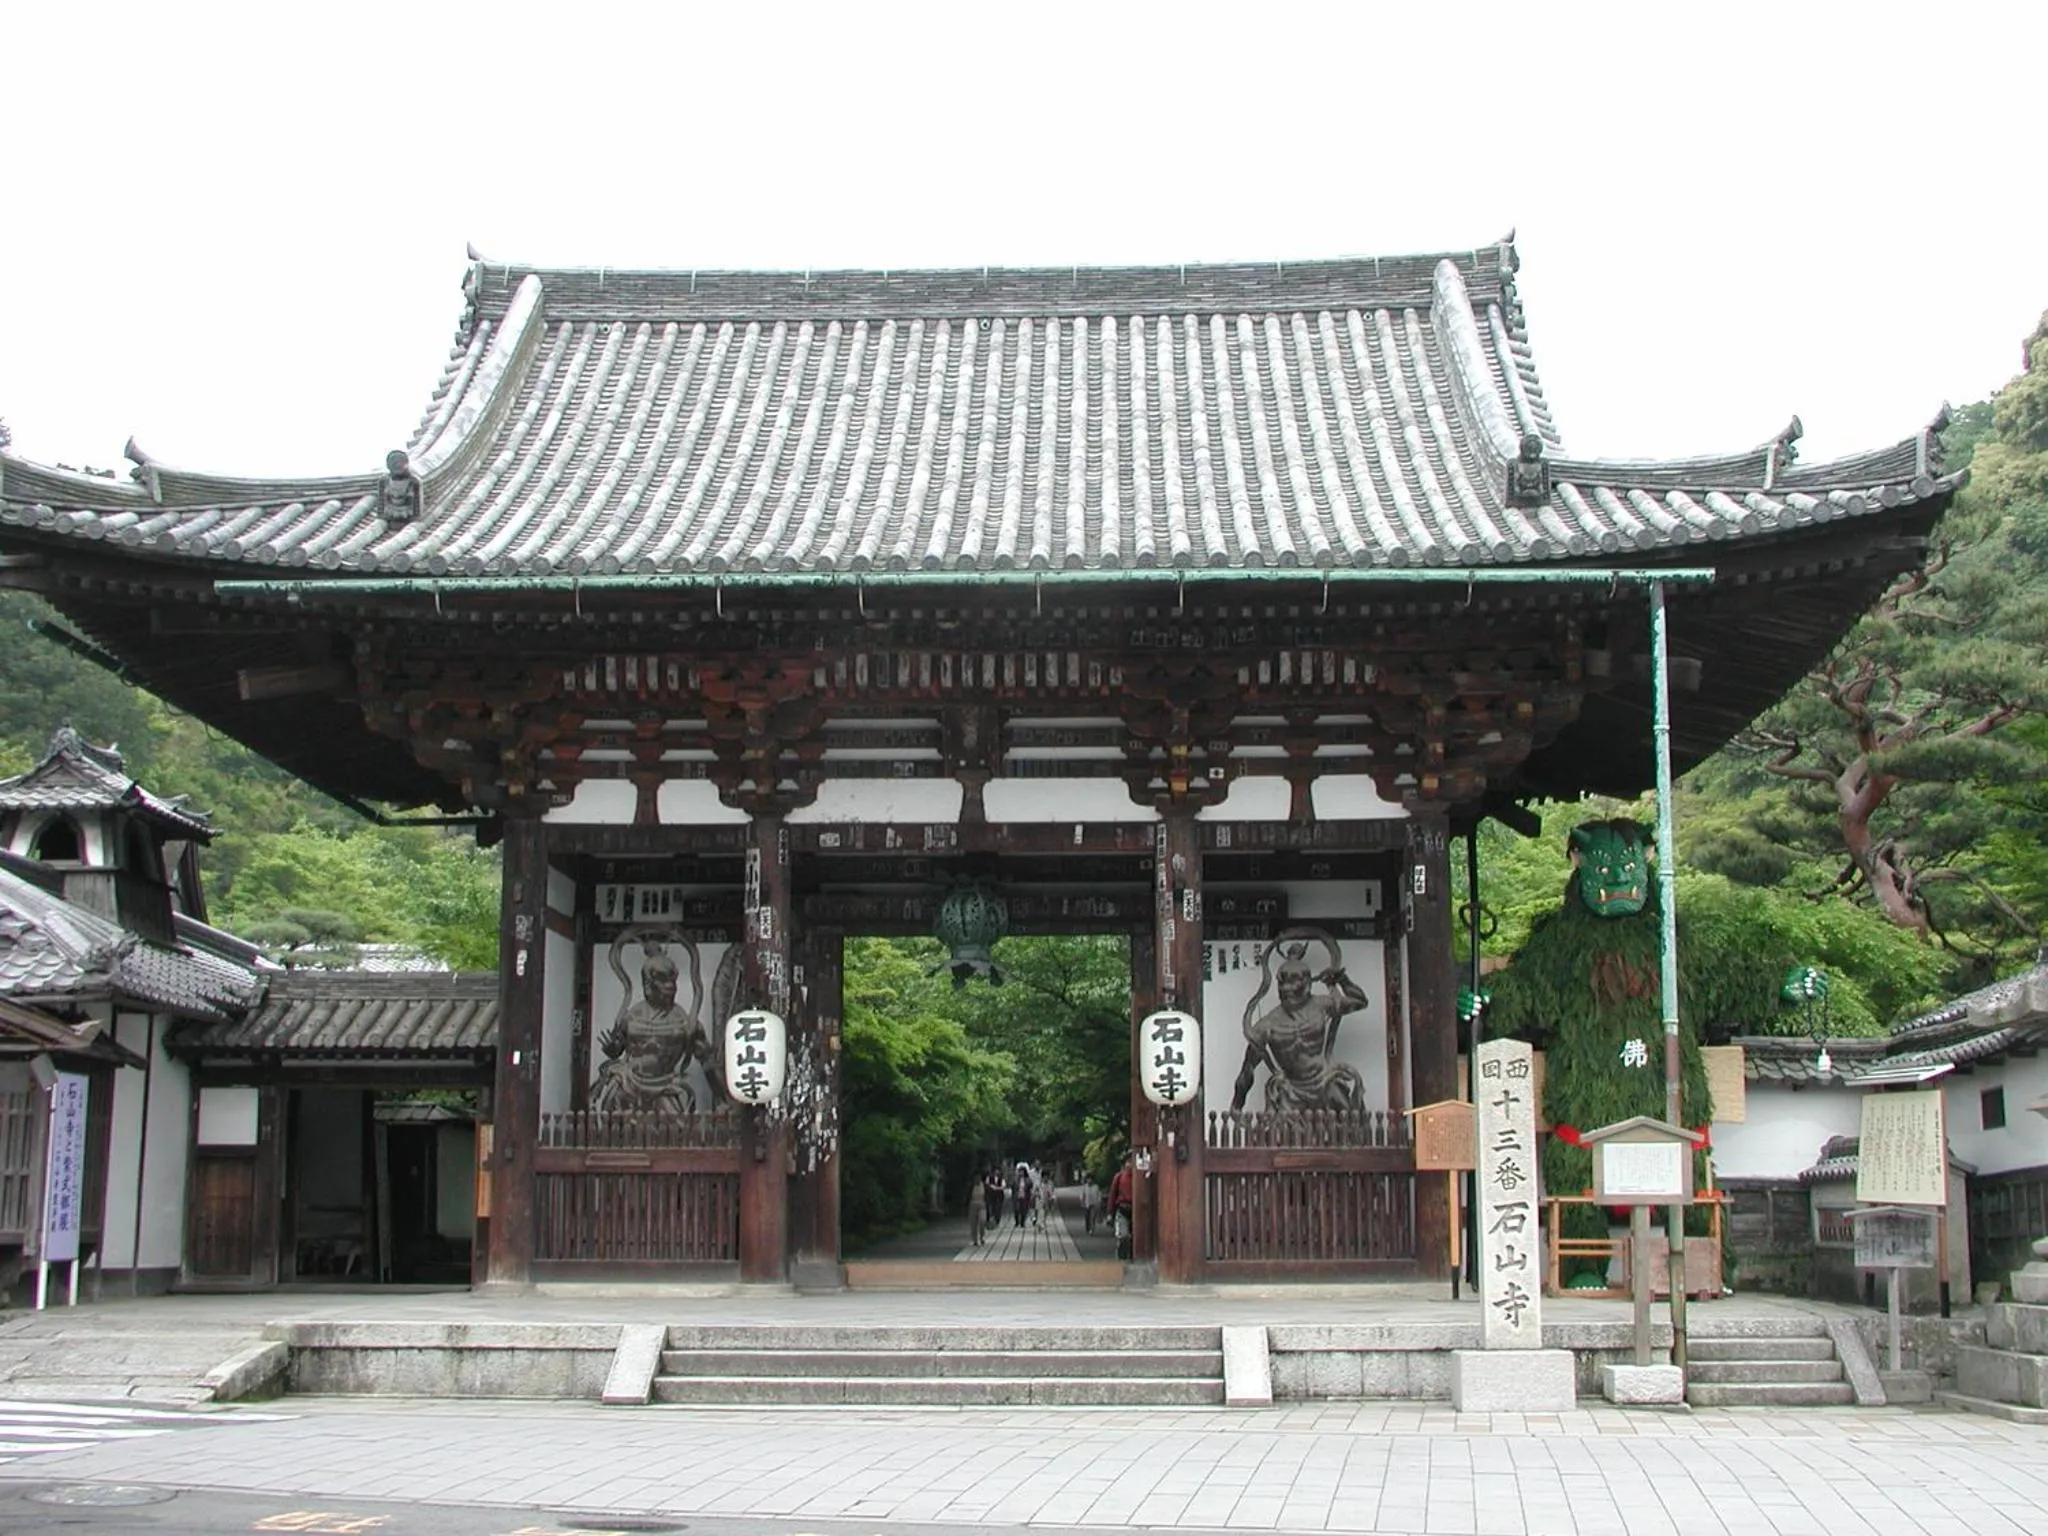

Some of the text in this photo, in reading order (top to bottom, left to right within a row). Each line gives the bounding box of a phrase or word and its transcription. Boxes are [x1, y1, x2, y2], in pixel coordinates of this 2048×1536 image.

[735, 1016, 769, 1099] 石山寺
[1152, 1016, 1187, 1100] 石山寺
[1619, 1038, 1648, 1068] 佛
